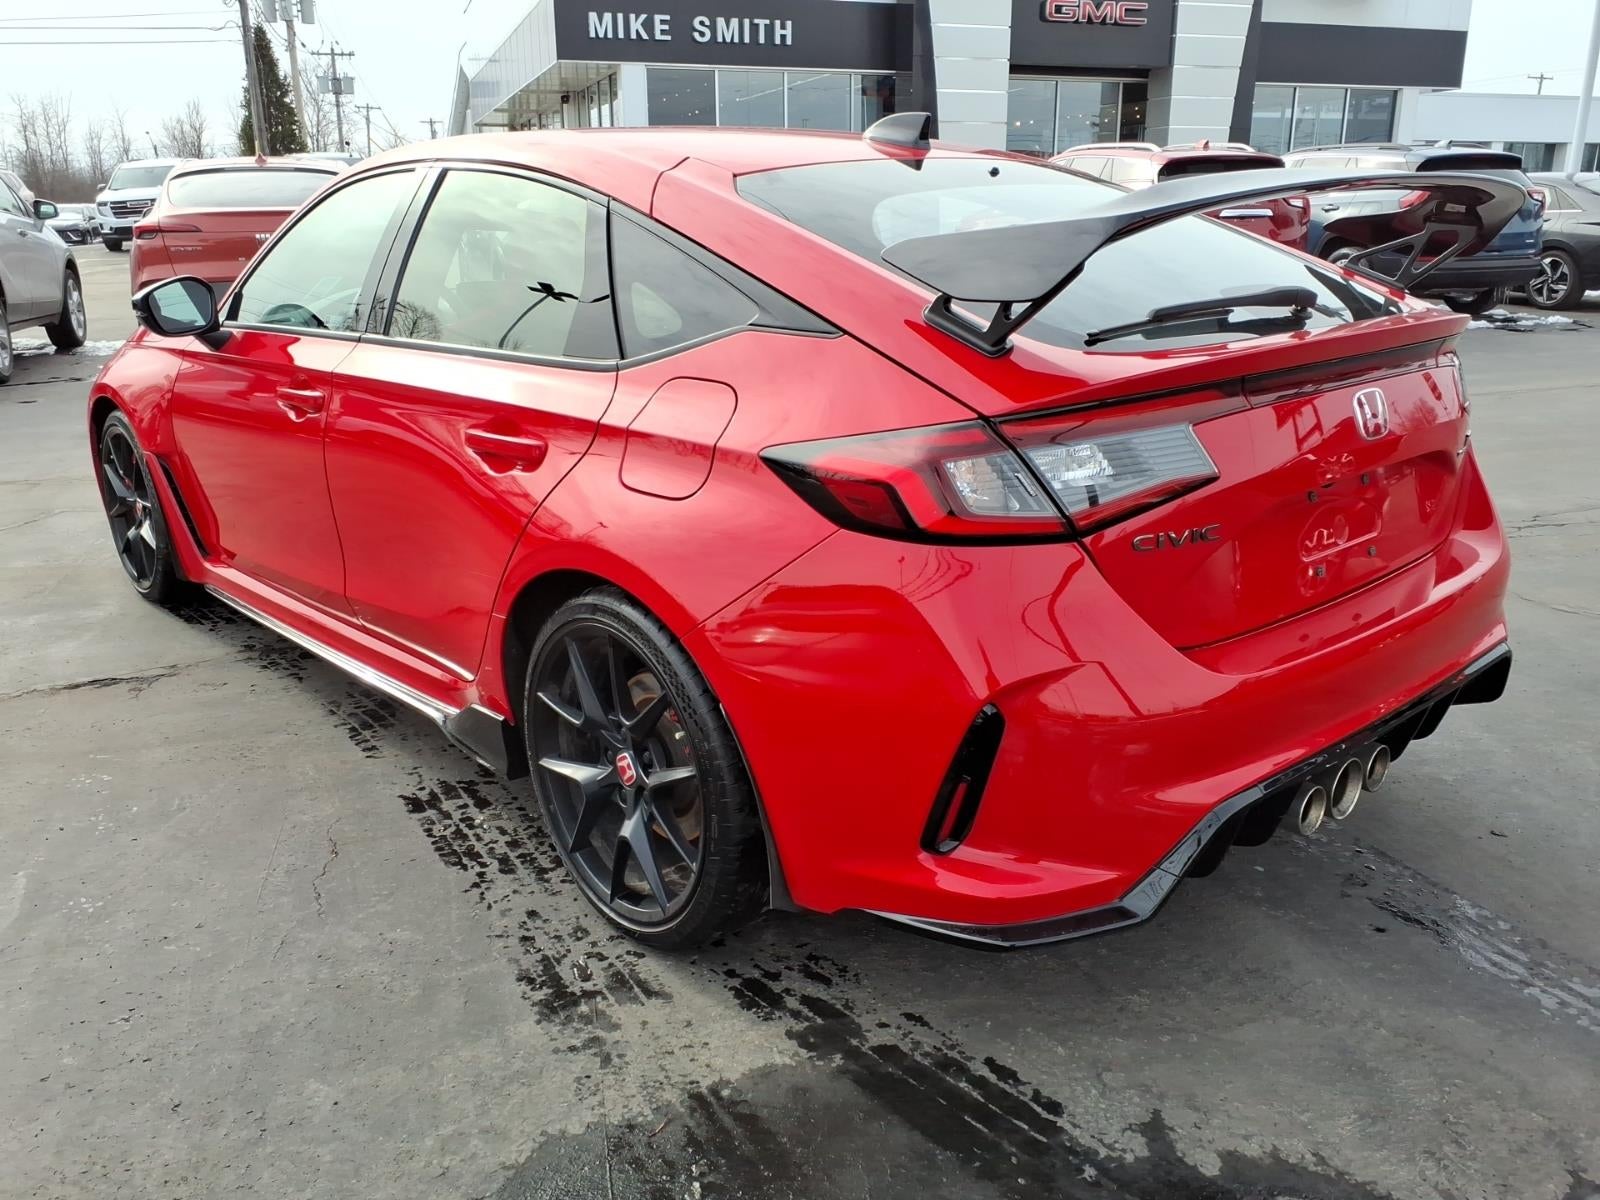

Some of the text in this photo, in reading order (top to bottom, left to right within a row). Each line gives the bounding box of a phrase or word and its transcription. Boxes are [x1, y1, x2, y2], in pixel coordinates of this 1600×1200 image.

[1045, 0, 1148, 25] GMC
[588, 12, 793, 45] MIKE SMITH
[1132, 524, 1221, 551] CIVIC
